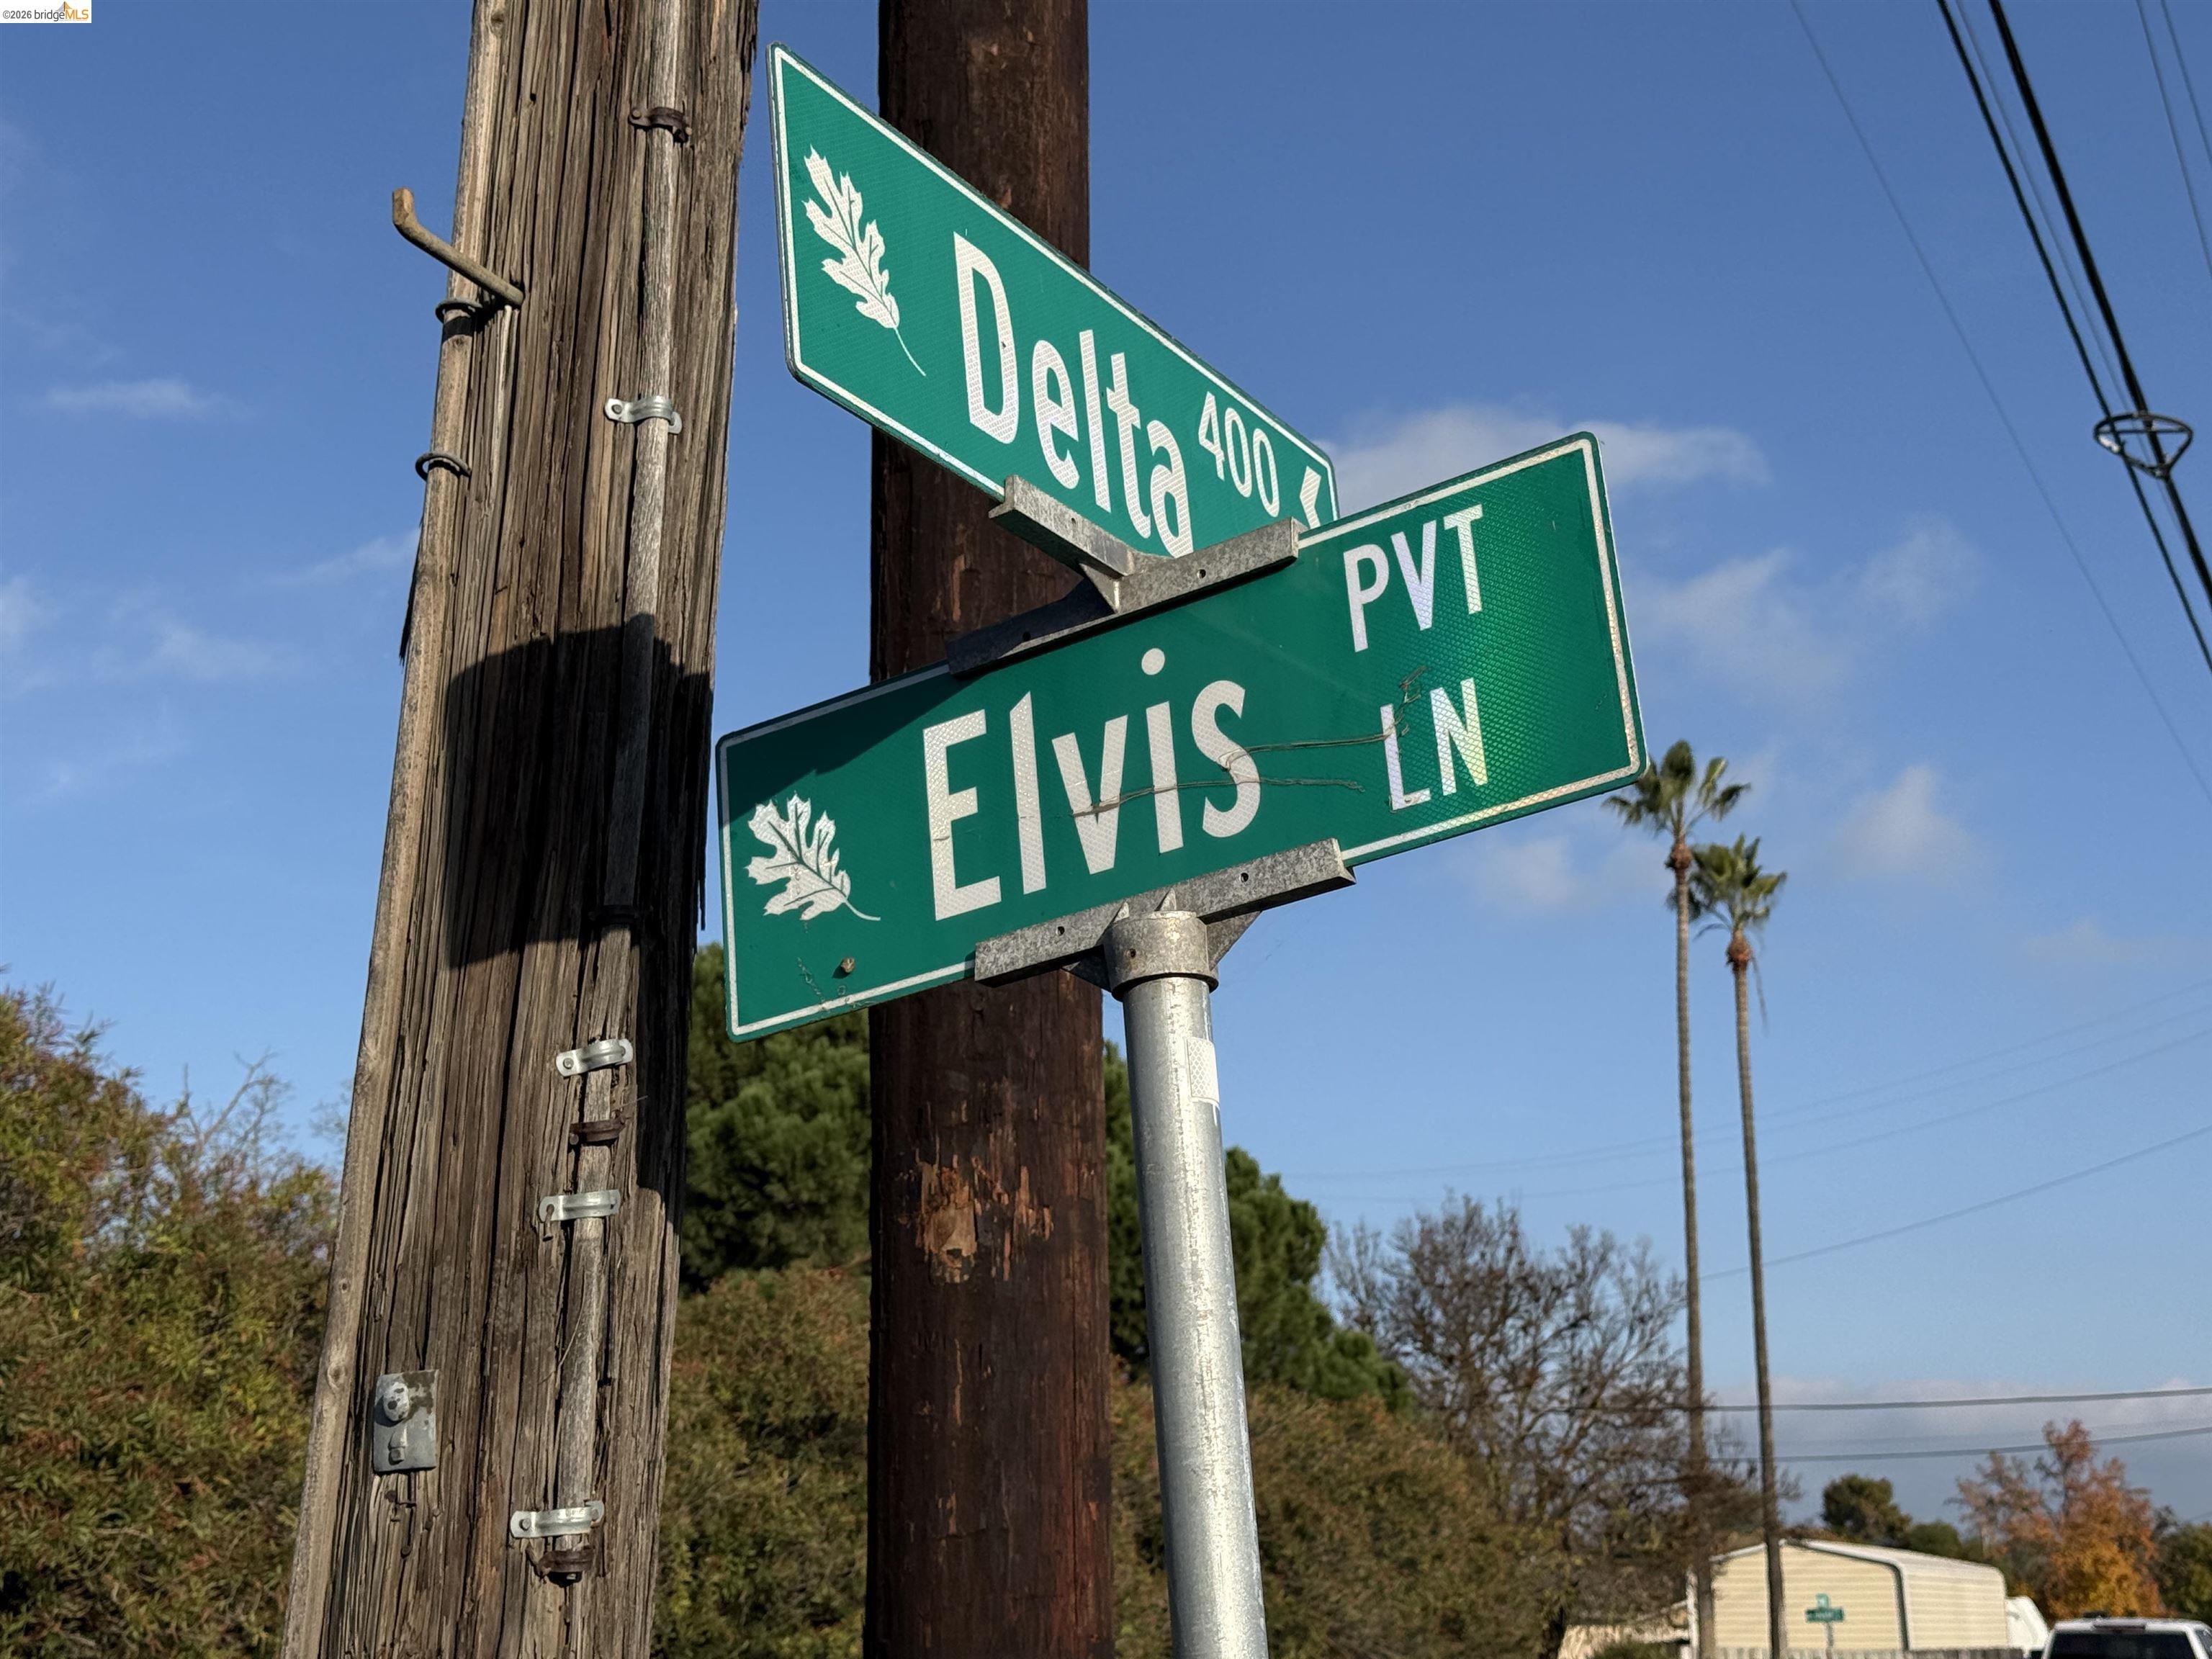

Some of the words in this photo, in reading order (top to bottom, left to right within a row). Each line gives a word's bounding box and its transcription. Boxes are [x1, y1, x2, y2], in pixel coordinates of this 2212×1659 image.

[953, 231, 1194, 559] Delta
[1198, 391, 1280, 518] 400
[1342, 503, 1484, 652] PVT
[922, 647, 1262, 922] Elvis
[1380, 677, 1489, 811] LN
